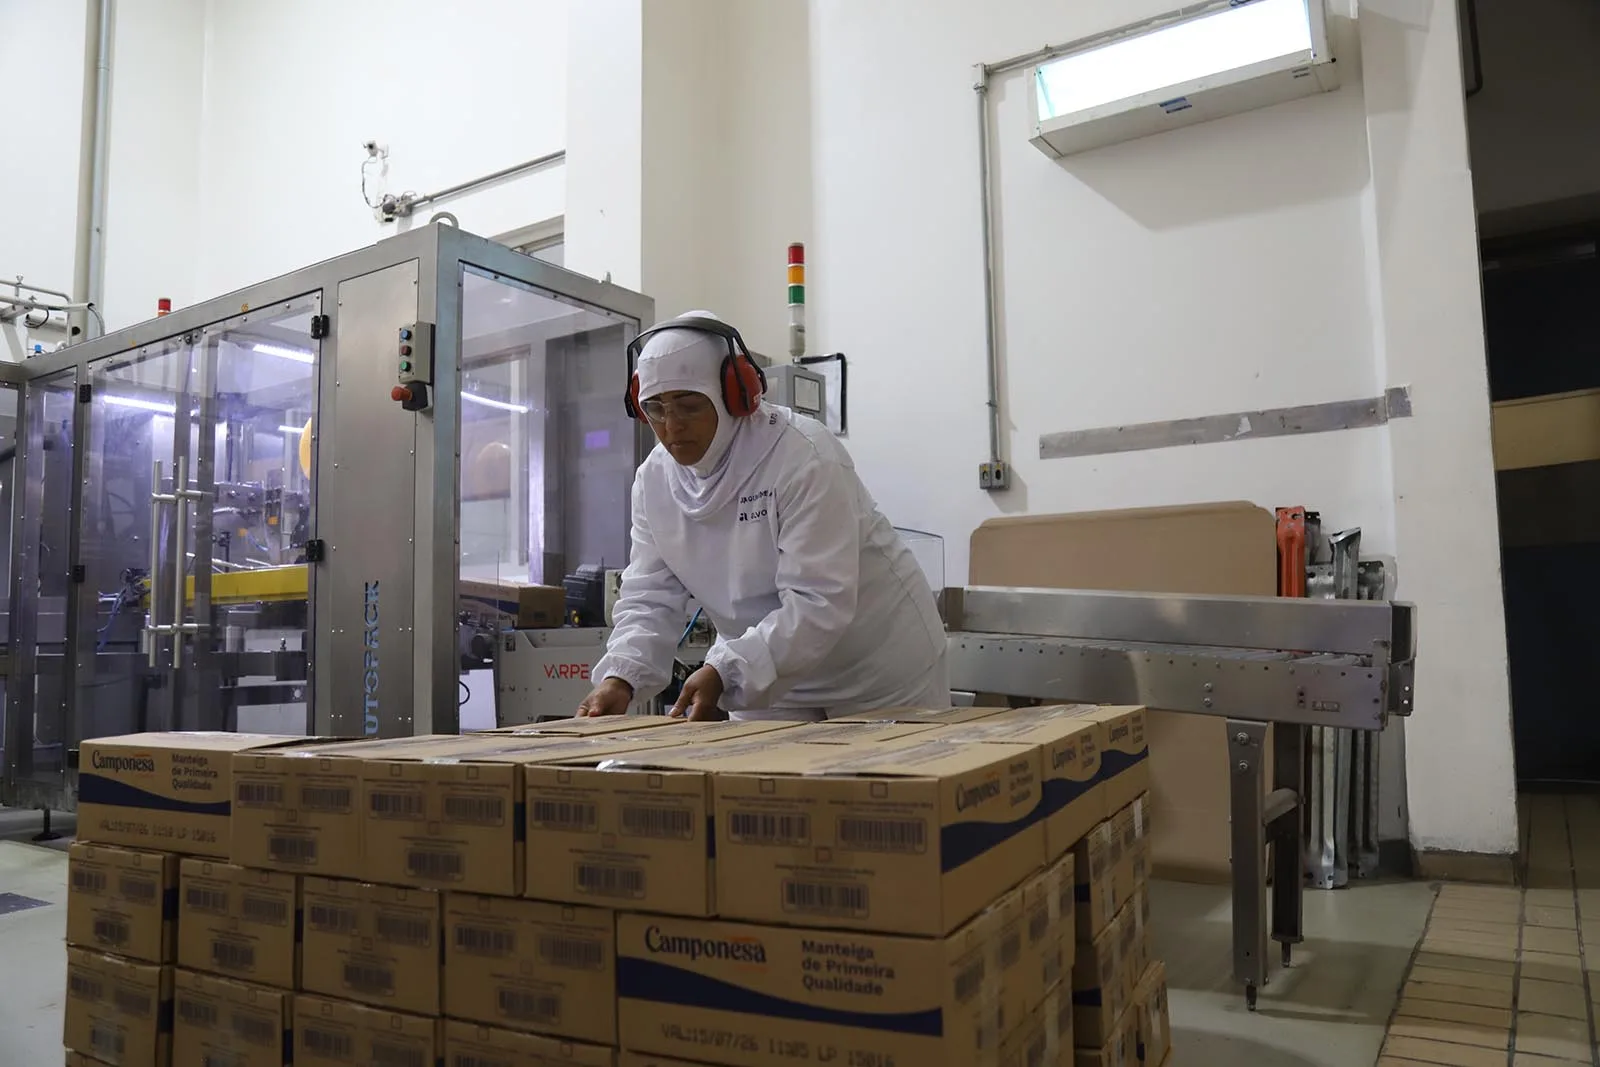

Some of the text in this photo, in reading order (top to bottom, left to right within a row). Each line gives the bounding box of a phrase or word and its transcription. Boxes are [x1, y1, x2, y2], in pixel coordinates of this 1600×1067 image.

[543, 663, 590, 680] VARPE
[92, 750, 155, 773] Camponesa
[644, 924, 768, 964] Camponesa
[801, 939, 875, 962] Manteiga
[801, 957, 896, 980] de Primeira
[802, 974, 884, 996] Qualidade
[817, 1040, 838, 1062] LP
